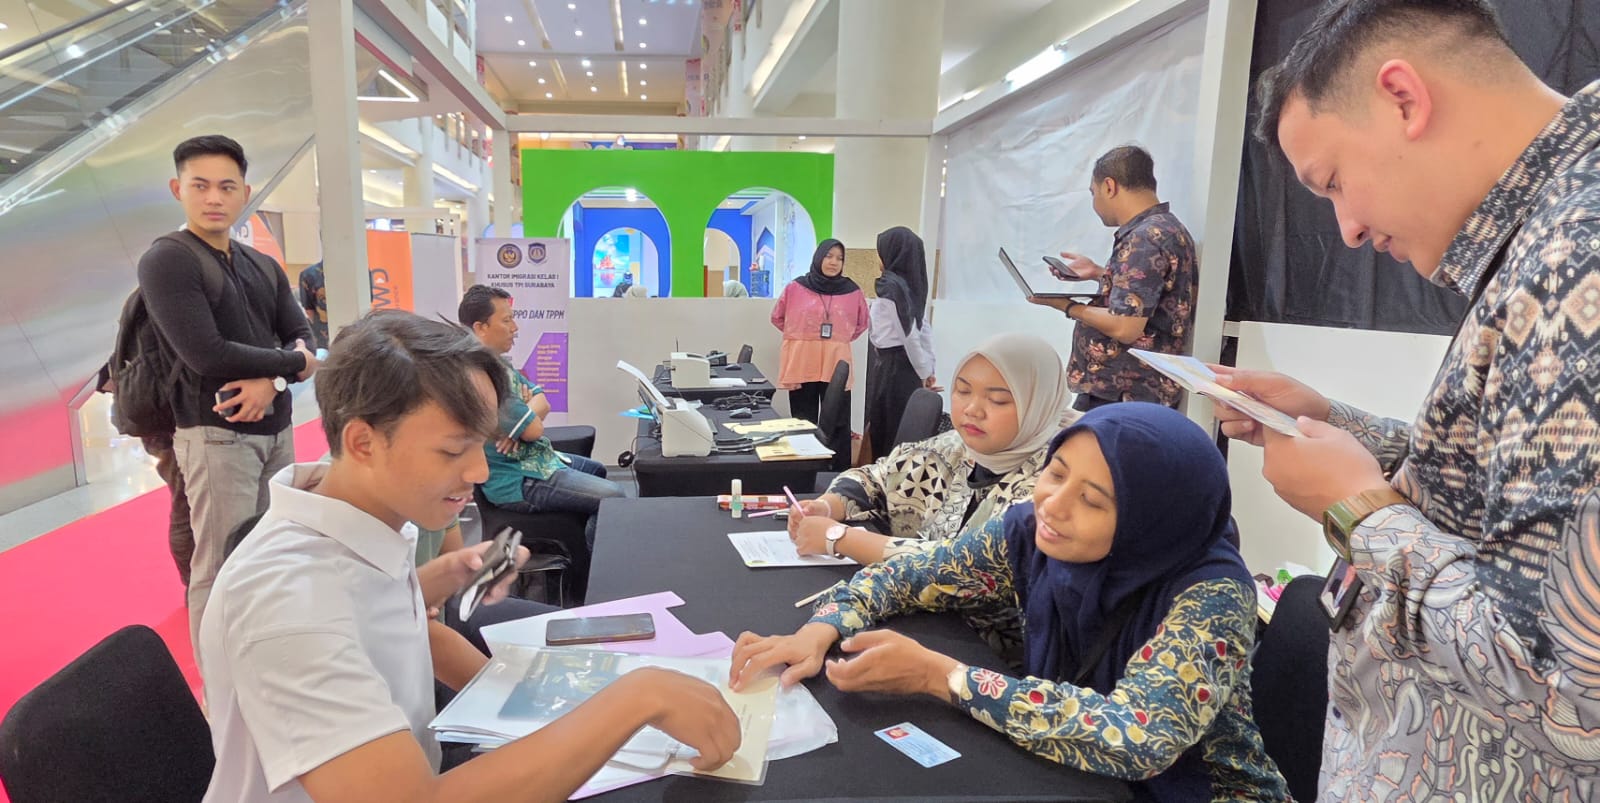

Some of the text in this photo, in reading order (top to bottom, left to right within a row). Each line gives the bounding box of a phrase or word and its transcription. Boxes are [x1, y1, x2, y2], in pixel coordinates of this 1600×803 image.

[369, 268, 391, 308] WD
[512, 310, 565, 320] PPO DAN TPPM
